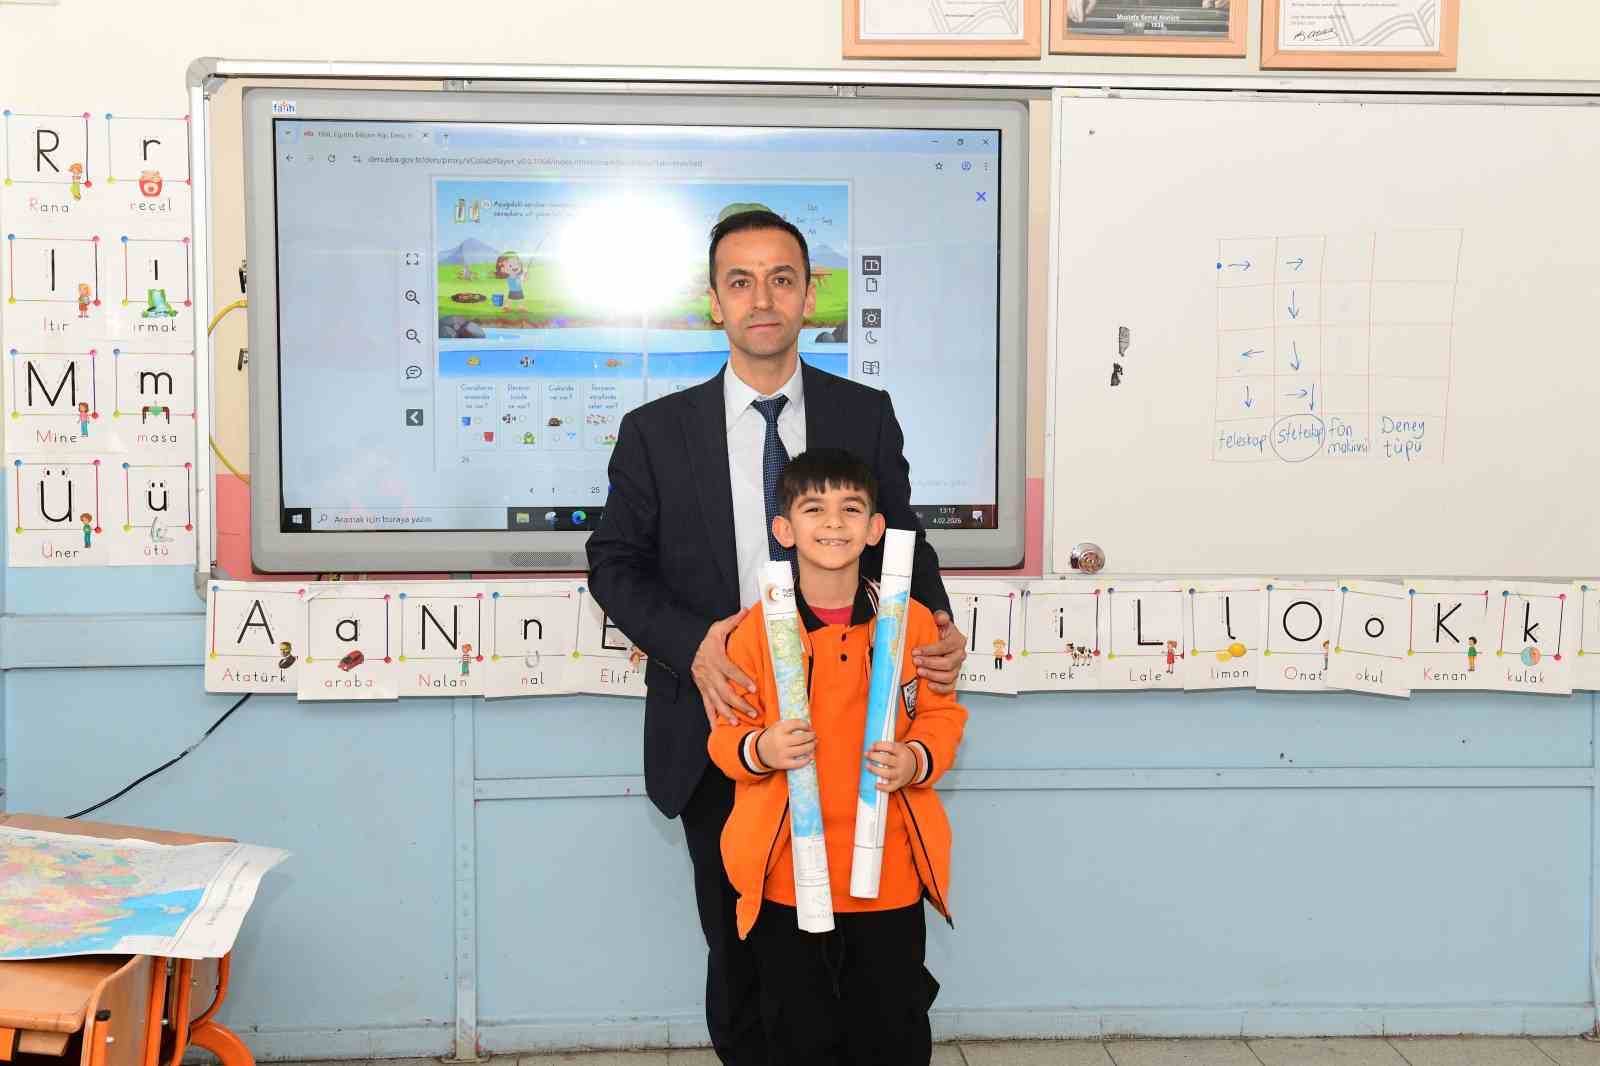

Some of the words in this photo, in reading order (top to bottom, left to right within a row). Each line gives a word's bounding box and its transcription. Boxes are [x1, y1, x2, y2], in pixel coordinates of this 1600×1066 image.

[36, 129, 60, 172] R
[143, 139, 161, 161] r
[28, 197, 71, 214] Rana
[27, 360, 76, 407] M
[140, 371, 173, 395] m
[35, 429, 79, 444] Mine
[136, 432, 178, 444] masa
[1382, 416, 1425, 440] Deney
[40, 469, 73, 523] Ü
[147, 482, 168, 512] ü
[237, 599, 275, 645] A
[335, 619, 359, 642] a
[421, 604, 458, 650] N
[523, 618, 543, 640] n
[1058, 607, 1064, 639] i
[1137, 599, 1164, 646] L
[1282, 600, 1323, 642] O
[1364, 617, 1385, 638] o
[1435, 602, 1463, 644] K
[1523, 602, 1540, 643] k
[221, 667, 289, 683] Atatürk
[324, 673, 374, 689] araba
[417, 673, 468, 689] Nalan
[520, 673, 545, 686] nal
[600, 668, 631, 685] Elif
[1045, 667, 1075, 681] inek
[1129, 666, 1163, 682] Lale
[1210, 667, 1249, 680] limon
[1284, 666, 1323, 681] Onat
[1355, 668, 1385, 684] okul
[1423, 667, 1468, 681] Kenan
[1507, 670, 1545, 684] kulak
